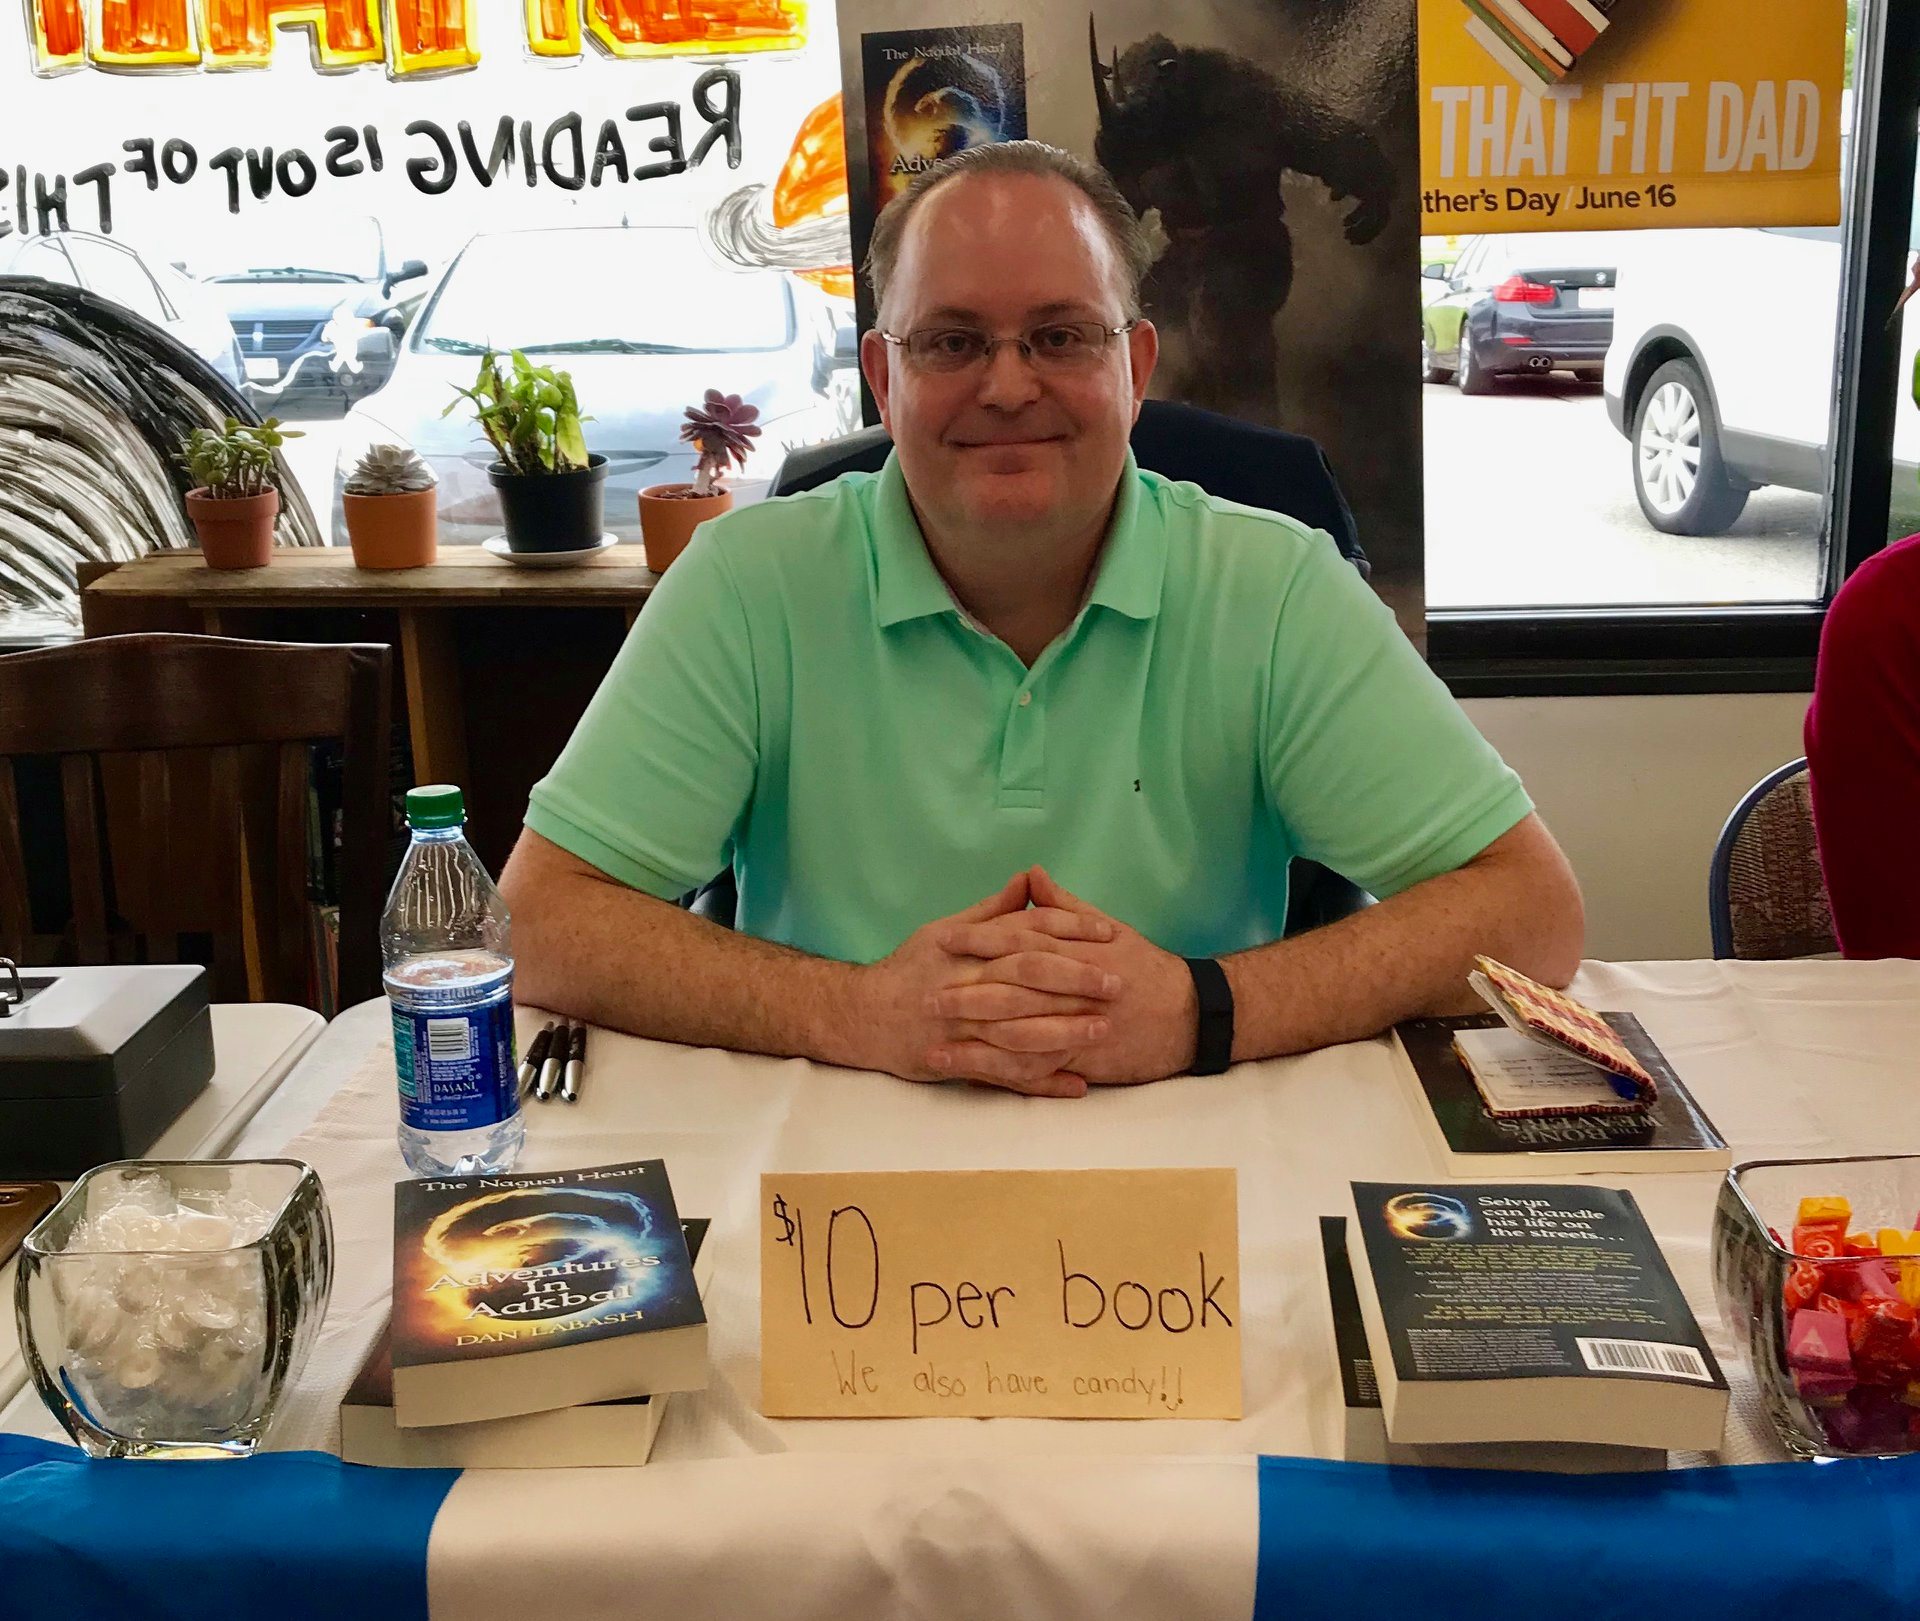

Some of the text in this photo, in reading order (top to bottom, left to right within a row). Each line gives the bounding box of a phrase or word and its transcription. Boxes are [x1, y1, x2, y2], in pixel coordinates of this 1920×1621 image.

[882, 48, 909, 61] The
[914, 46, 961, 61] Nagual
[1431, 80, 1821, 178] THAT FIT DAD
[1420, 188, 1499, 214] ther's
[1507, 187, 1560, 216] Day
[1575, 186, 1641, 210] June
[1645, 184, 1677, 208] 16
[433, 1081, 476, 1094] DASANI
[1518, 1127, 1610, 1144] BONE
[418, 1166, 646, 1192] The Nagual Heart
[1477, 1196, 1551, 1208] Selvyn
[1482, 1207, 1606, 1220] can handle
[1485, 1217, 1593, 1230] his life on
[1490, 1227, 1526, 1237] the
[425, 1254, 662, 1292] Adventures
[772, 1193, 1233, 1354] $10 per book
[522, 1278, 571, 1298] In
[463, 1284, 635, 1321] Aakbal
[455, 1309, 646, 1346] DAN LABASH
[831, 1348, 879, 1397] We
[913, 1361, 967, 1397] also
[986, 1360, 1048, 1394] have
